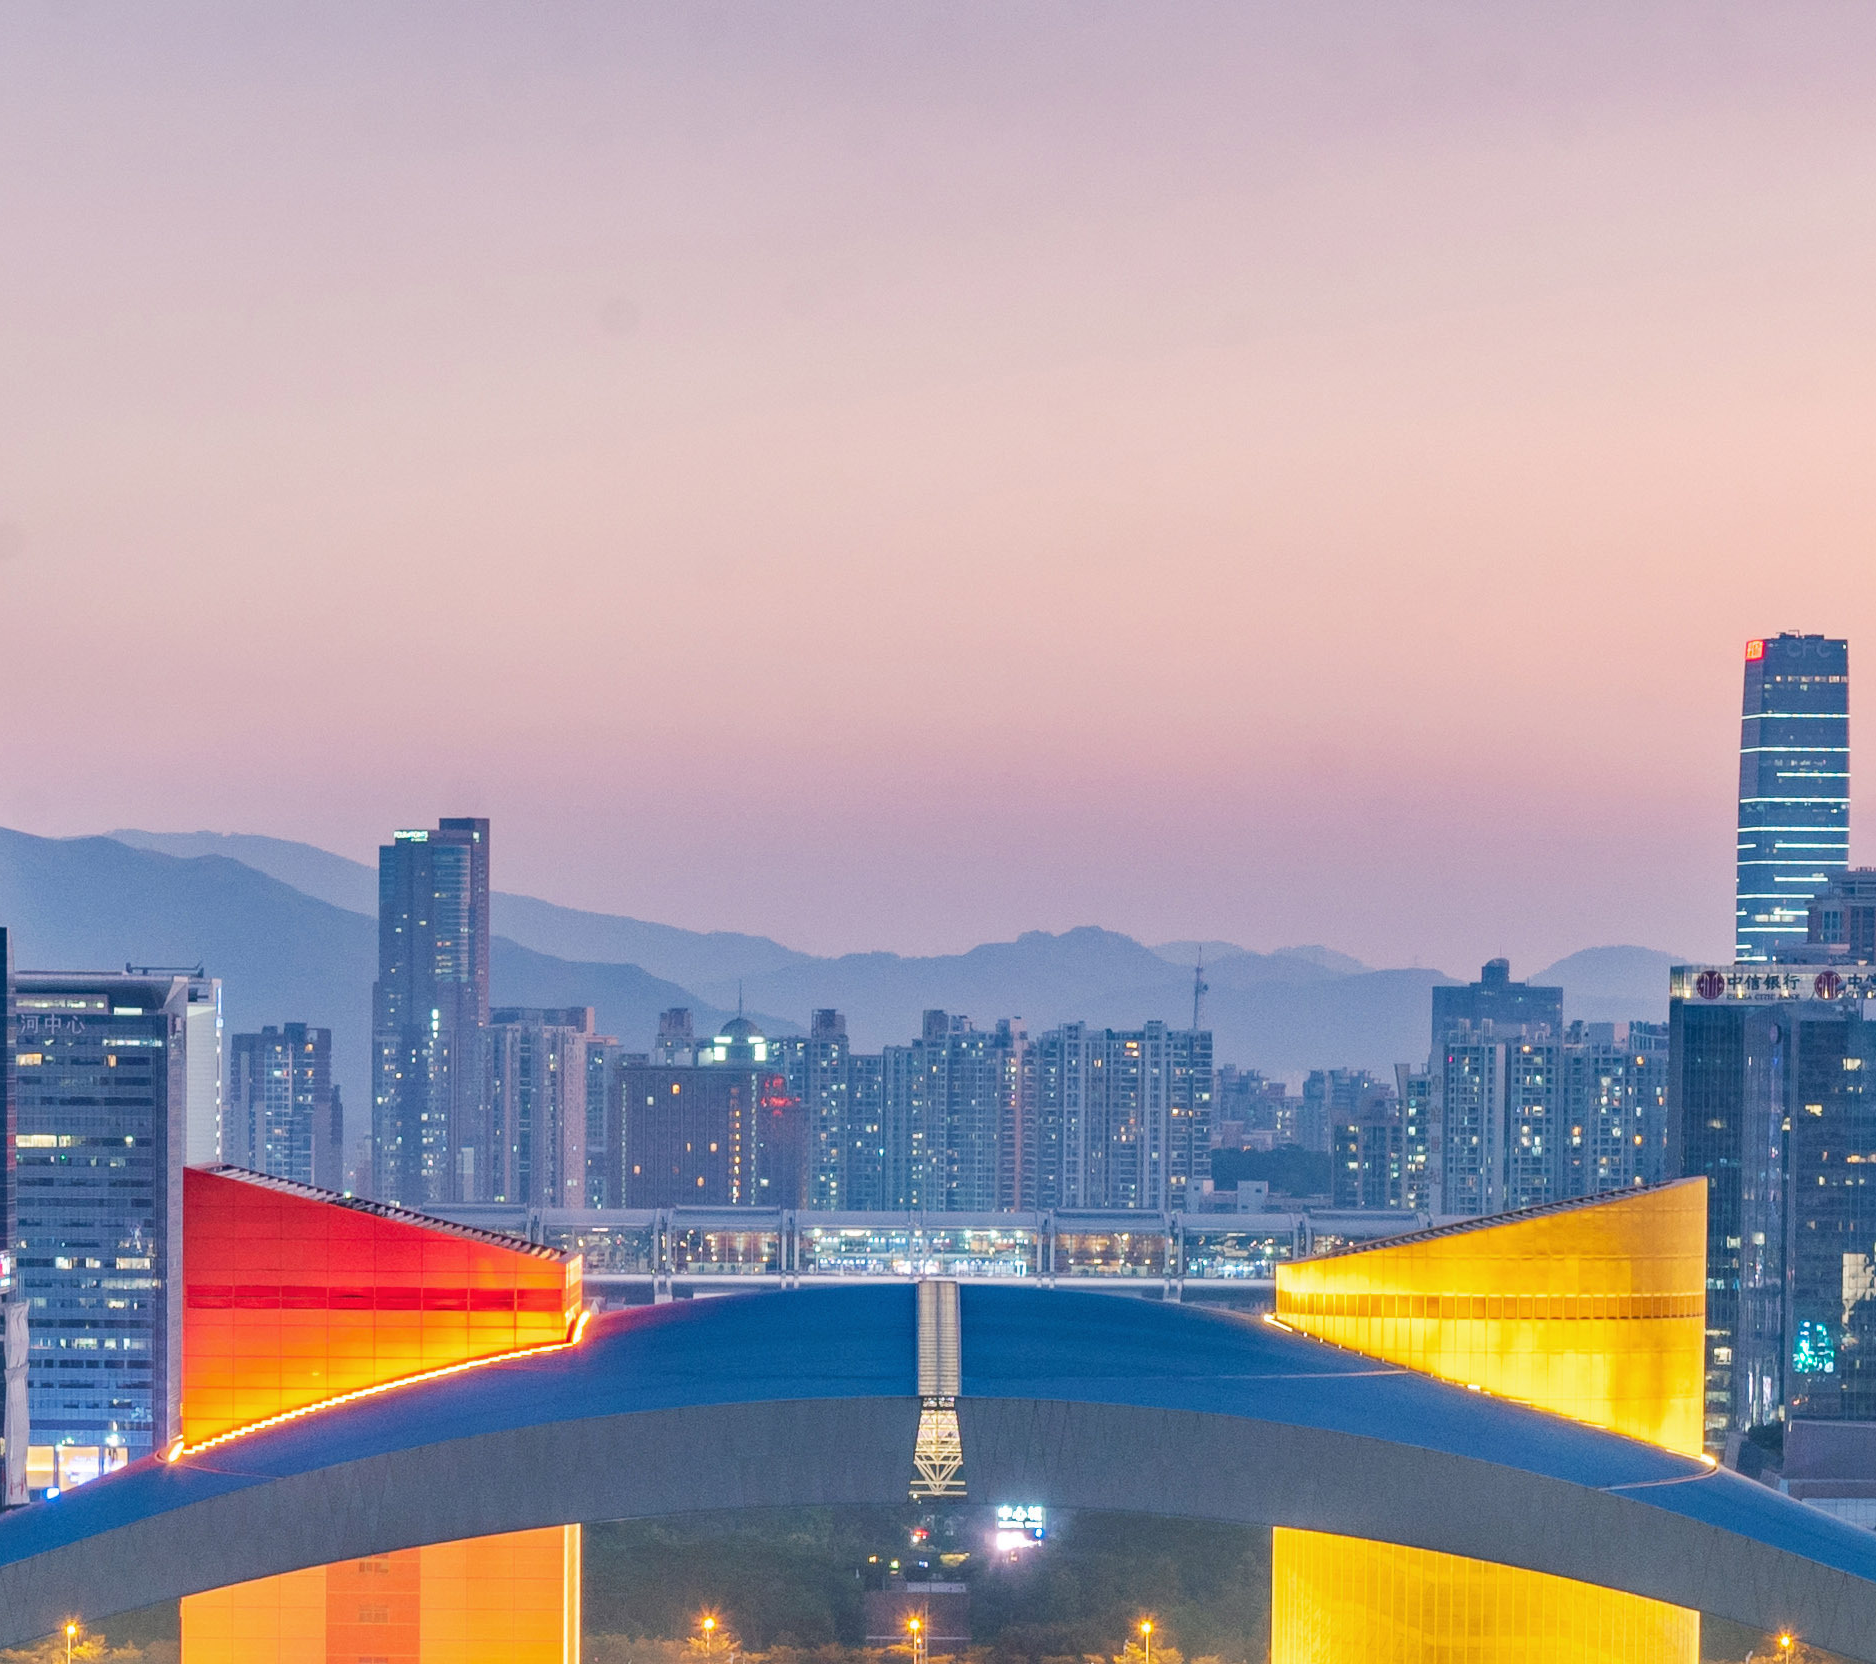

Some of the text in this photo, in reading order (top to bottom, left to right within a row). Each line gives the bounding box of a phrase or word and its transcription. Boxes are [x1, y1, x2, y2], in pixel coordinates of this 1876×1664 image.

[1727, 973, 1801, 991] 中信银行
[20, 1013, 86, 1035] 河中心
